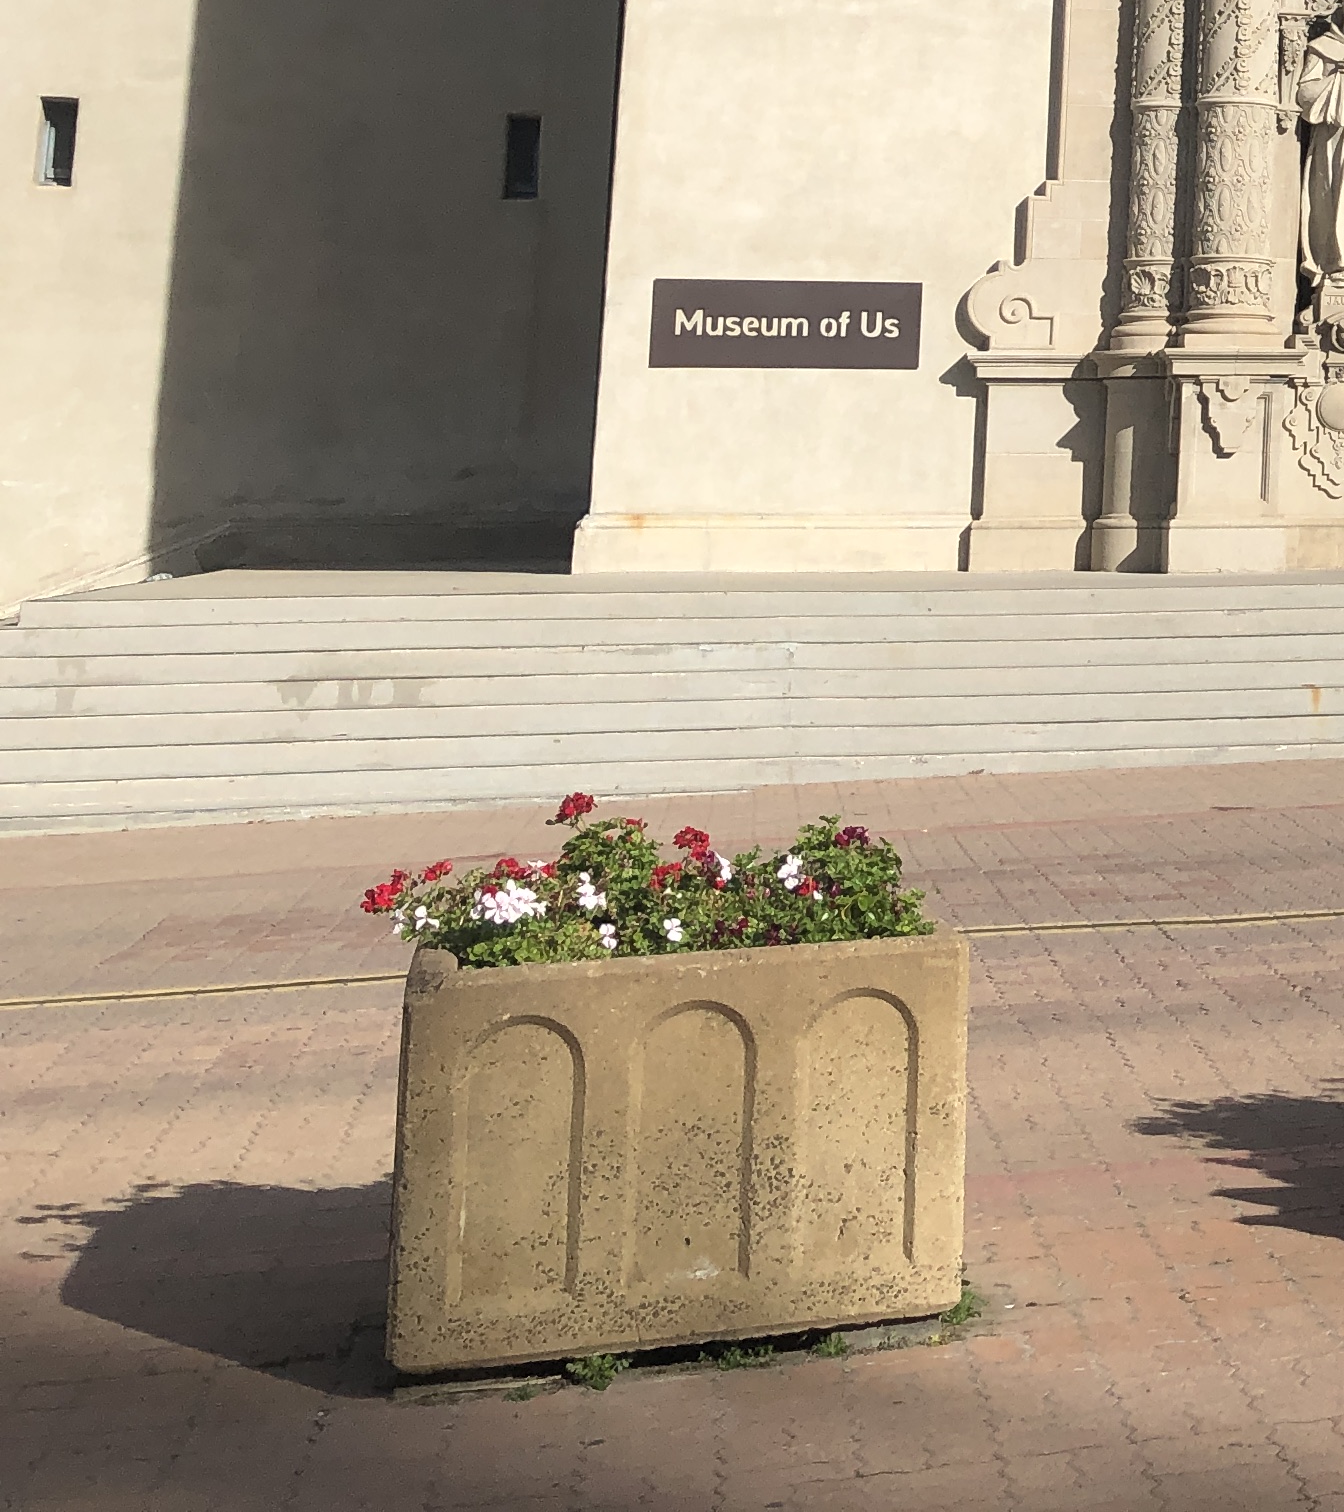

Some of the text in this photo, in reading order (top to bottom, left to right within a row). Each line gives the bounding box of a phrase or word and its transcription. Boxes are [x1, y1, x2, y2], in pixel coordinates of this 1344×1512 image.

[674, 309, 900, 338] Museum of Us
